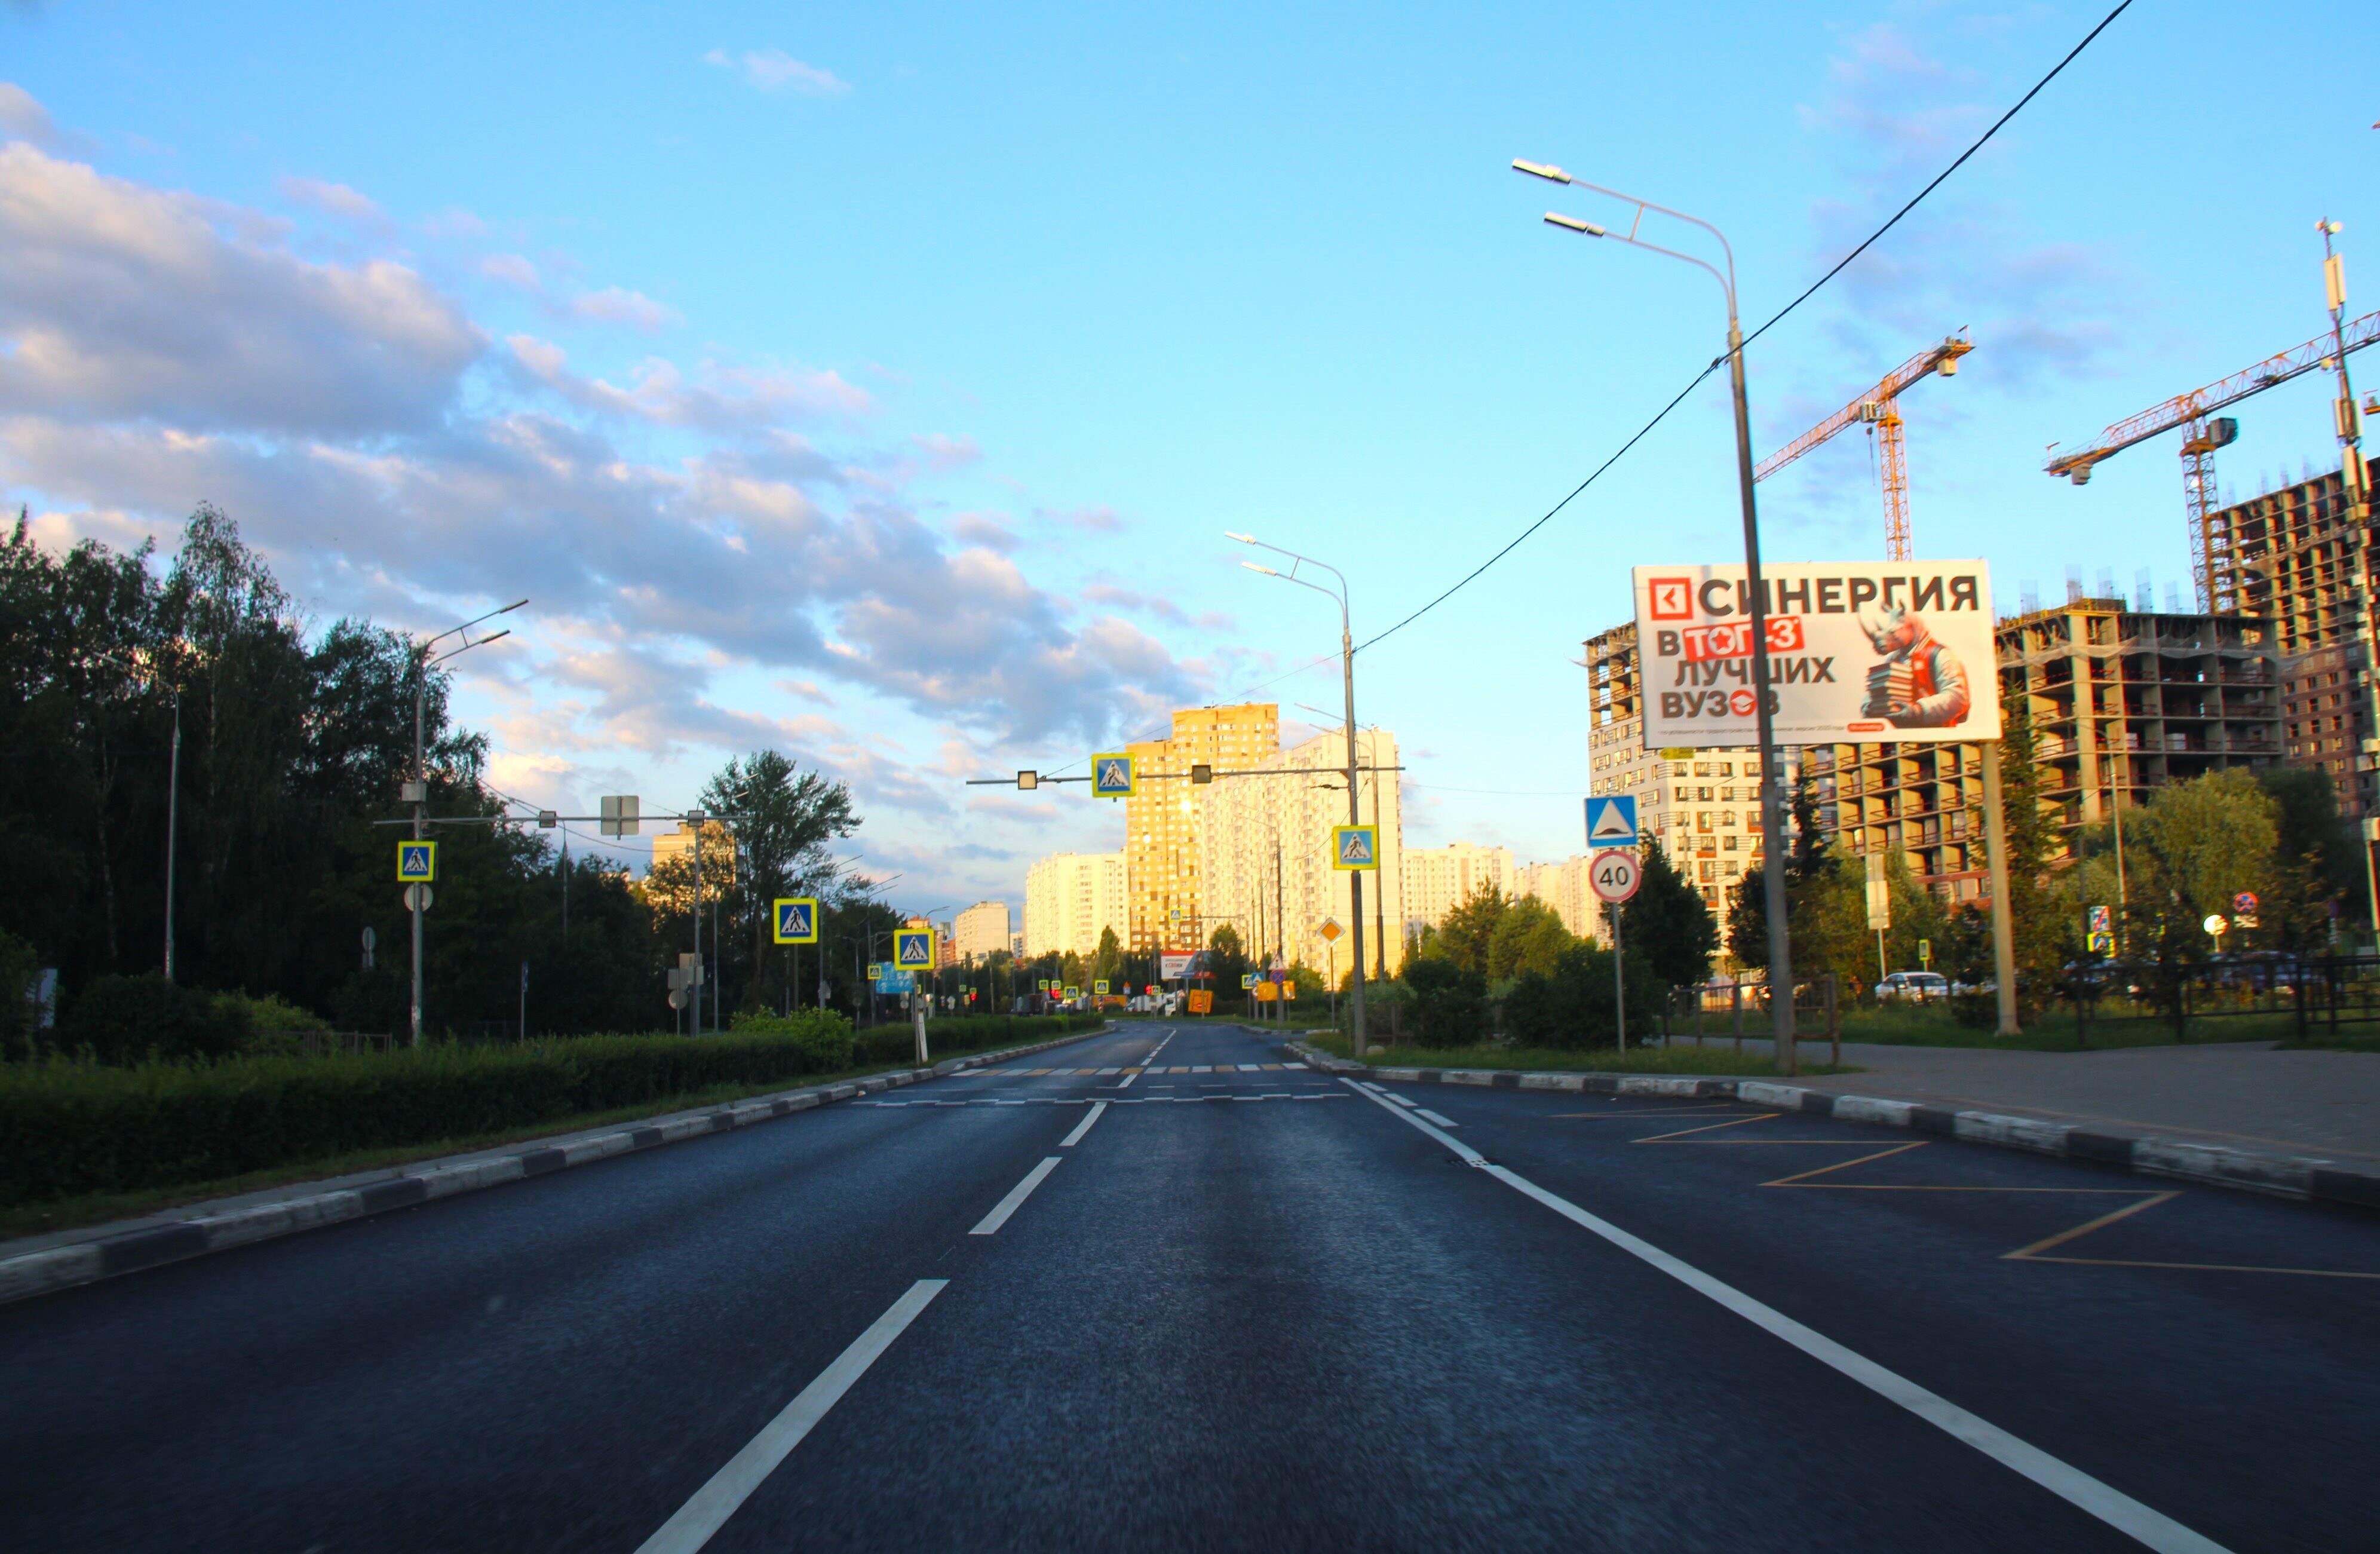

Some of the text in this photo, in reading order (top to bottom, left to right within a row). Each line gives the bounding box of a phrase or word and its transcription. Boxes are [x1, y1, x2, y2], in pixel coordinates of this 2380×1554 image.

[1698, 576, 1979, 616] СИНЕРГИЯ
[1658, 630, 1680, 656] В
[1674, 657, 1836, 686] ЛУЧШИХ
[1599, 866, 1628, 887] 40
